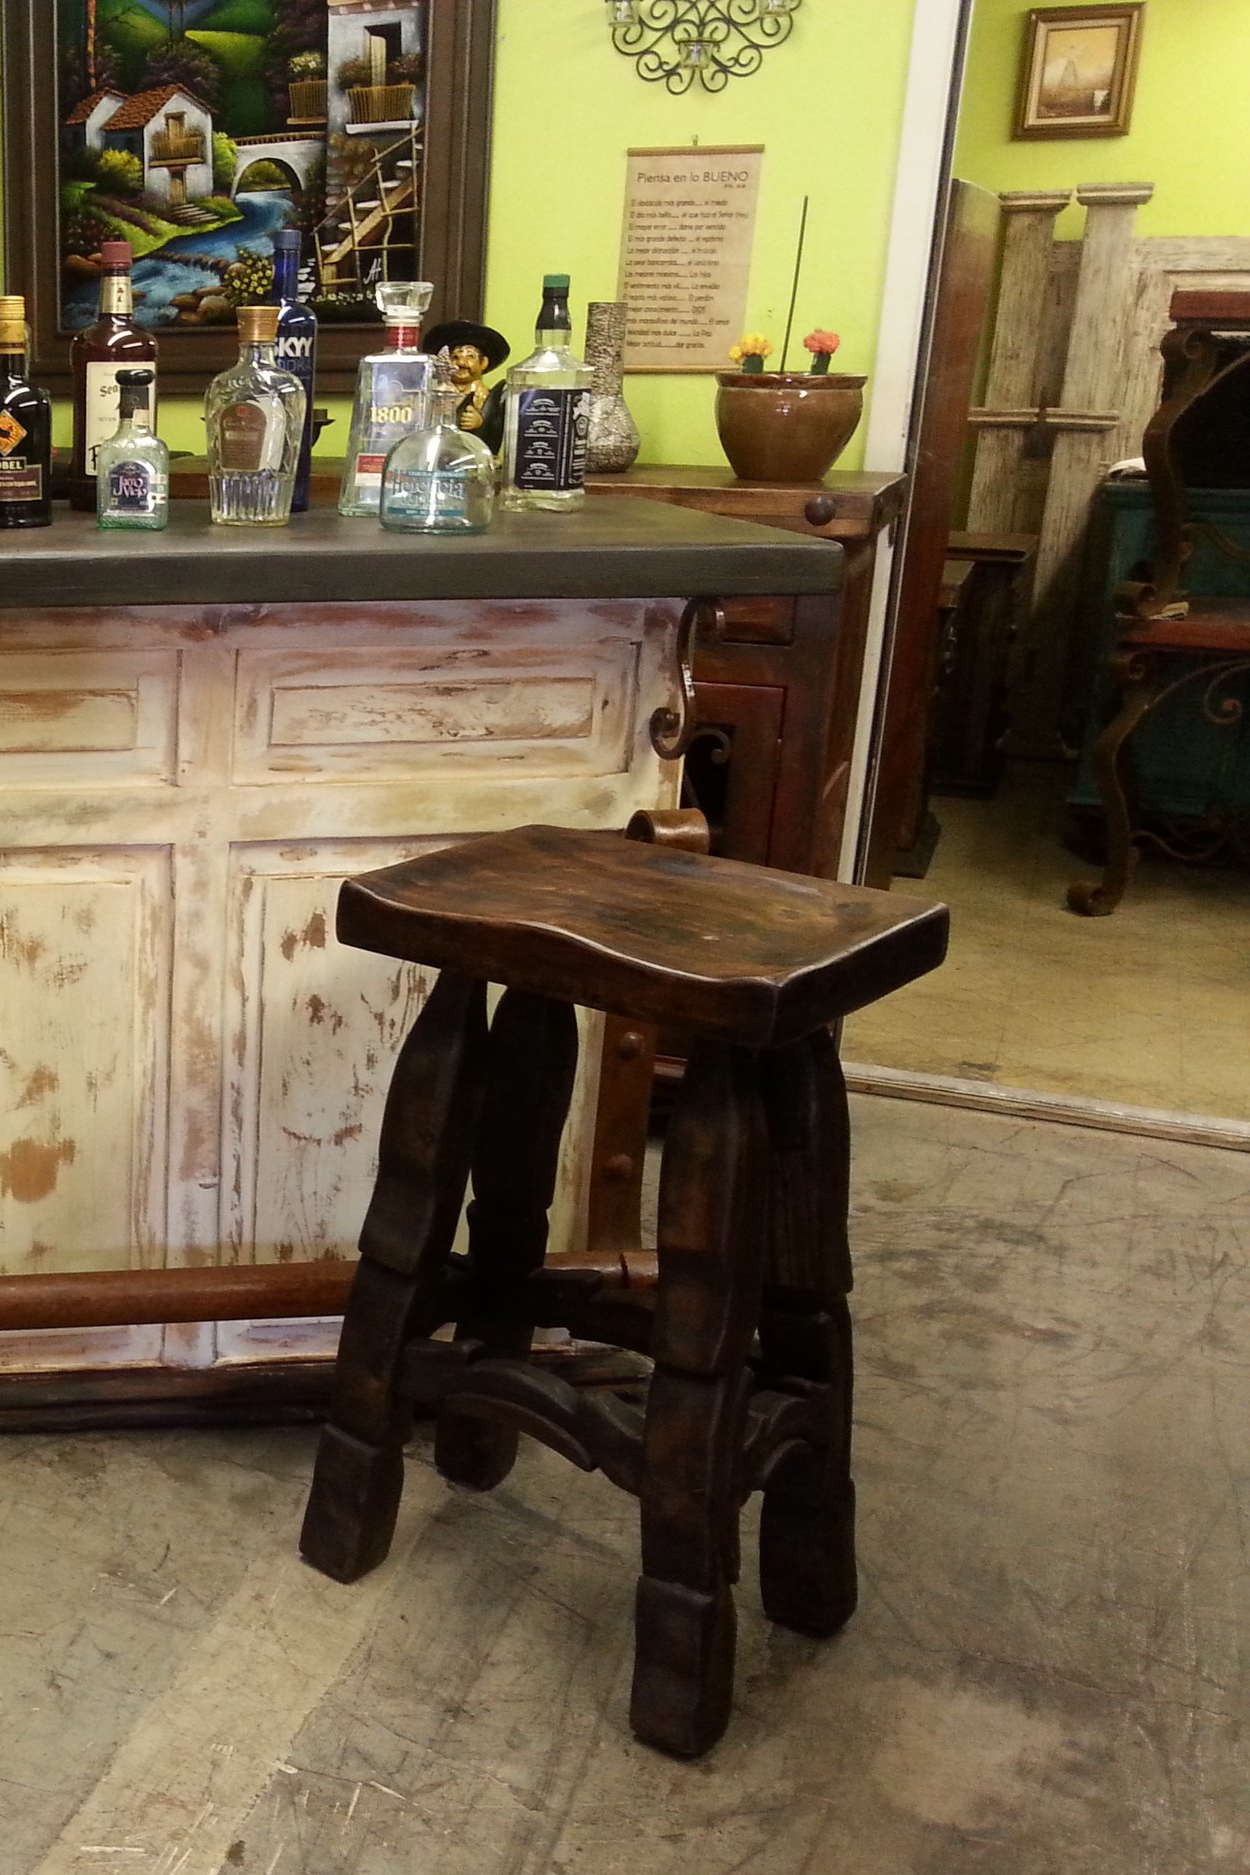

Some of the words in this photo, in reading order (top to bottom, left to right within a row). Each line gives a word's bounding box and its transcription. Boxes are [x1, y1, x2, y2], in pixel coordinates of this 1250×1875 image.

[636, 172, 670, 183] Piensa
[673, 174, 687, 182] en
[691, 171, 700, 182] lo
[702, 170, 749, 182] BUENO
[370, 406, 412, 424] 1800
